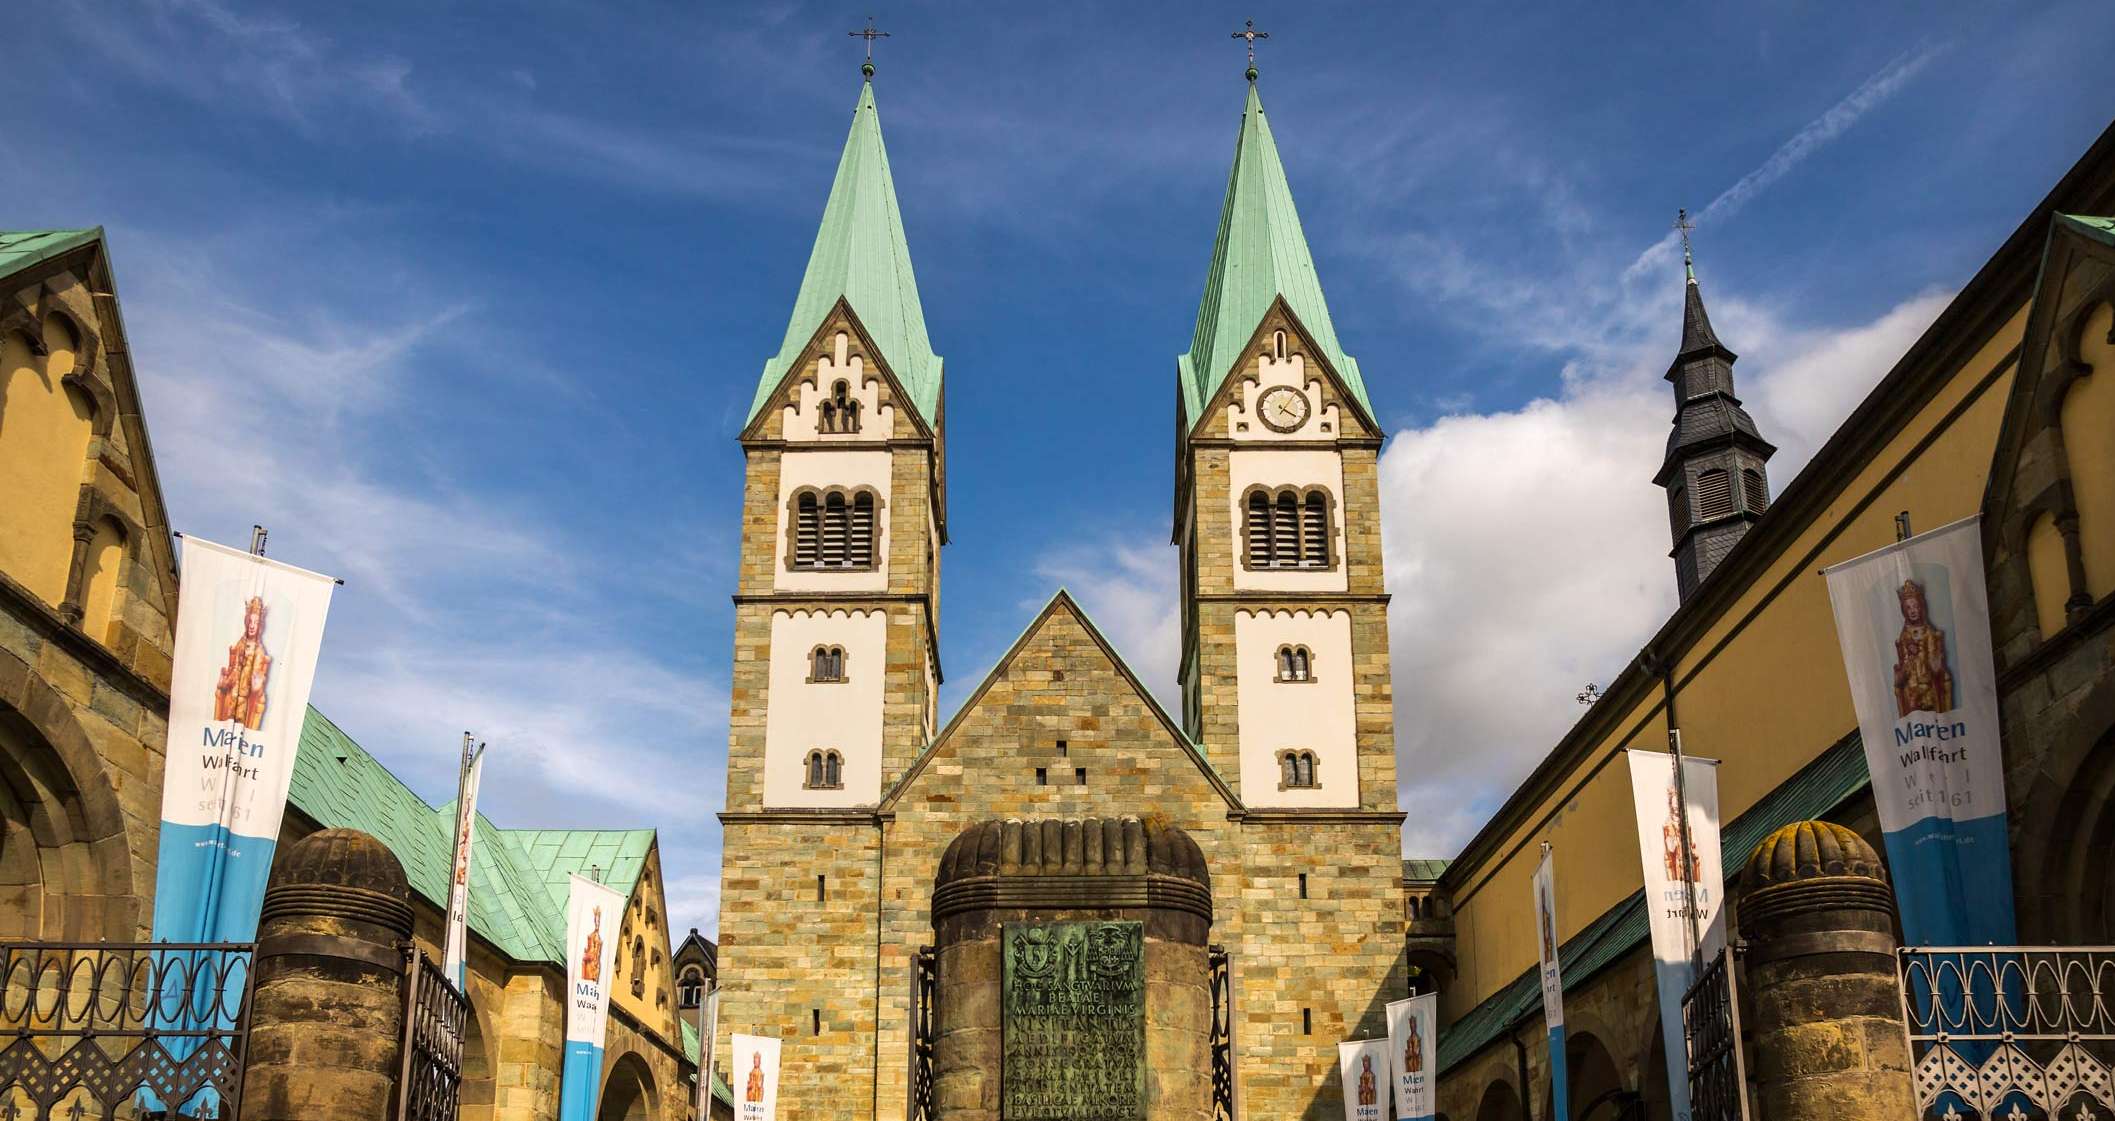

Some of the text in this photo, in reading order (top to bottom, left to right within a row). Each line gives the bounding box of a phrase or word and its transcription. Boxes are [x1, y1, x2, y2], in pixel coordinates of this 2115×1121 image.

[1939, 790, 1972, 807] 161
[1048, 980, 1136, 991] SANCTVARIVM
[1049, 992, 1101, 1003] BEATAE
[1014, 1004, 1137, 1015] MARIAE VIRGINIS
